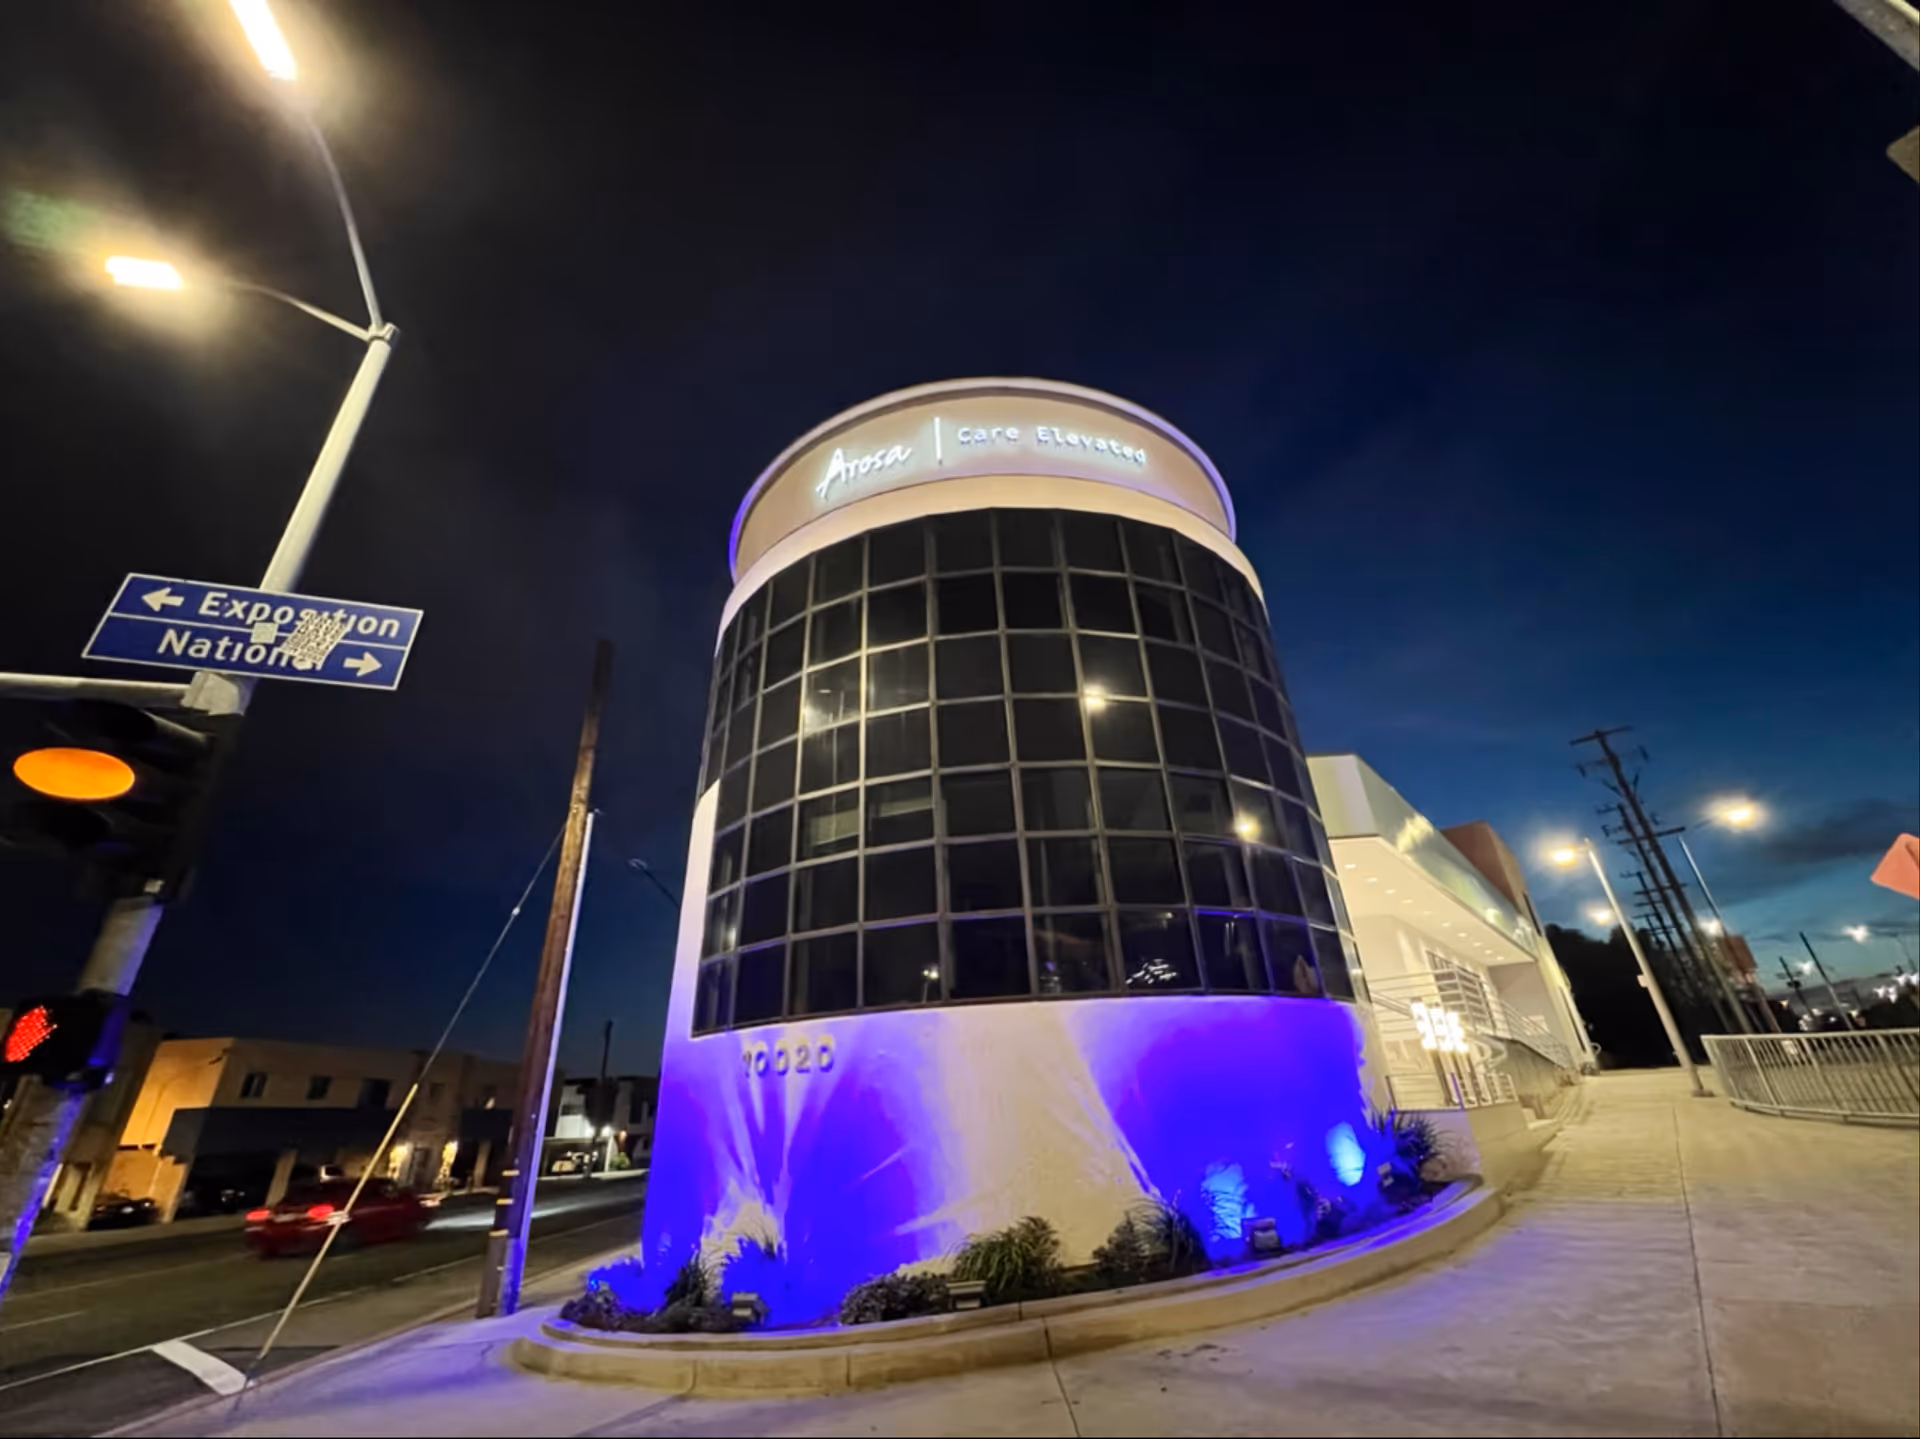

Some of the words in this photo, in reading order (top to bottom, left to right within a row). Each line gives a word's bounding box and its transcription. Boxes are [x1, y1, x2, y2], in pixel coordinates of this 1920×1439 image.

[815, 445, 913, 498] Arosa
[957, 426, 1020, 445] Care
[1036, 425, 1147, 466] Elevated
[157, 629, 325, 671] Nationa
[742, 1034, 834, 1077] 10020
